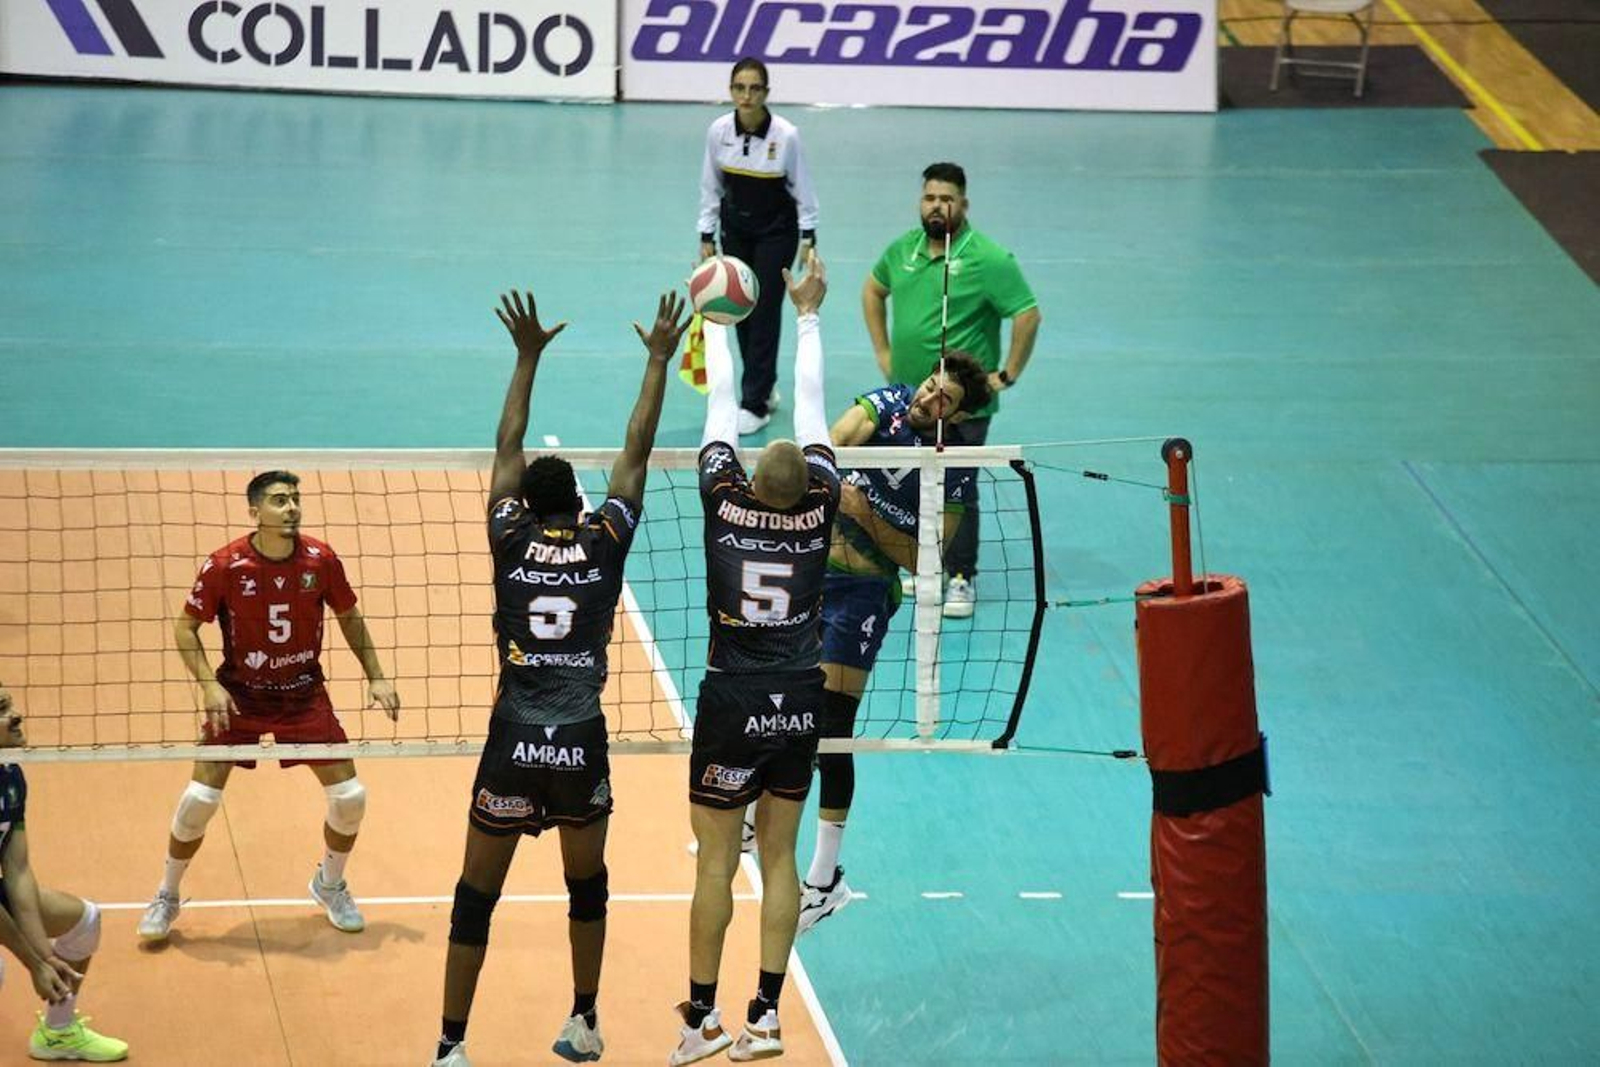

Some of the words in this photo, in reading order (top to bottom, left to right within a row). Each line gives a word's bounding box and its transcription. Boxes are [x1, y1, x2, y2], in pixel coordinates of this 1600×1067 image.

[188, 0, 594, 77] COLLADO
[631, 0, 1203, 72] alcazaba
[717, 499, 825, 531] HRISTOSKOV
[718, 533, 825, 553] ASCALE
[508, 567, 602, 585] ASCALE
[741, 561, 793, 622] 5
[268, 603, 291, 643] 5
[861, 614, 876, 637] 4
[744, 711, 816, 734] AMBAR
[511, 741, 587, 767] AMBAR
